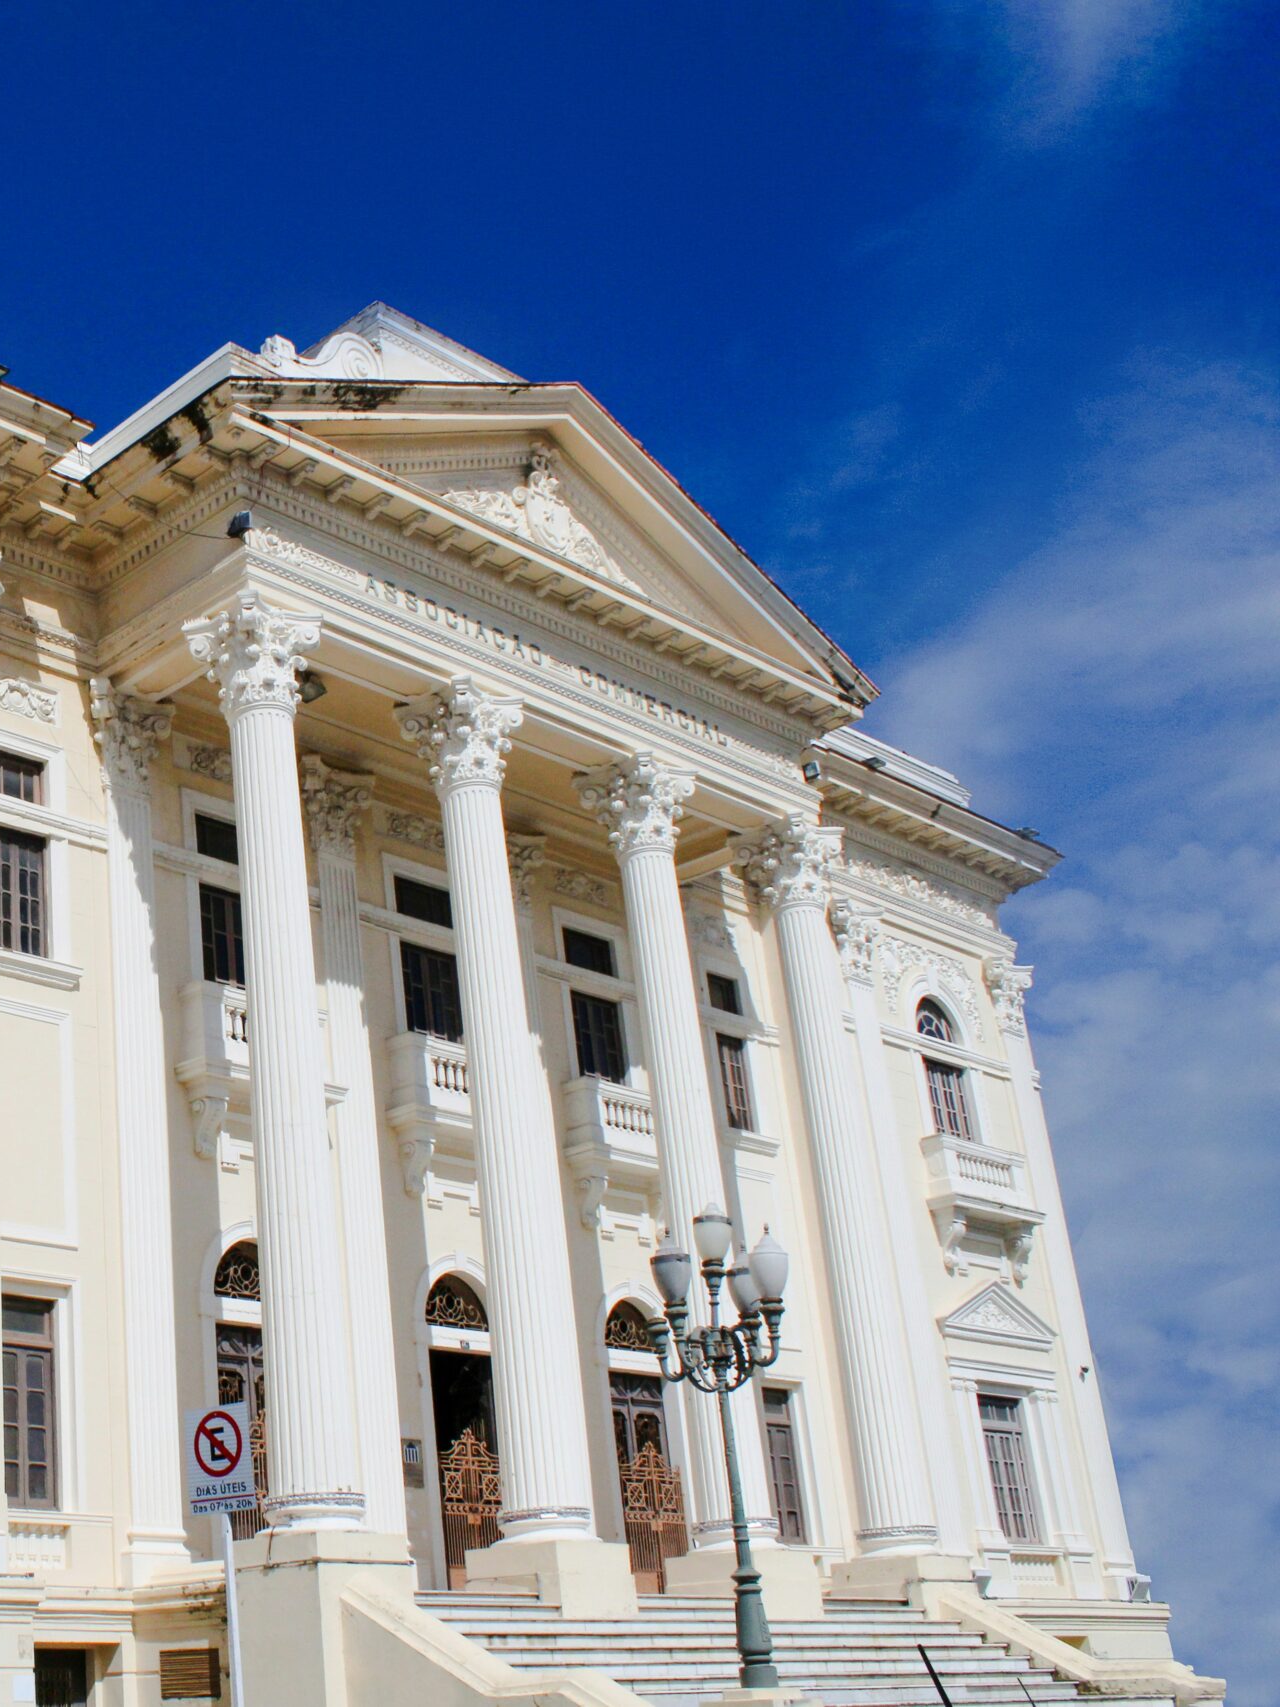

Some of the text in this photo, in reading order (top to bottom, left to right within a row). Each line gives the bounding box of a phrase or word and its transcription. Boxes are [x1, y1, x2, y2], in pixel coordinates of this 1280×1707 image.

[578, 664, 729, 747] COMMERCIAL
[196, 1480, 247, 1497] DIAS ÚTEIS
